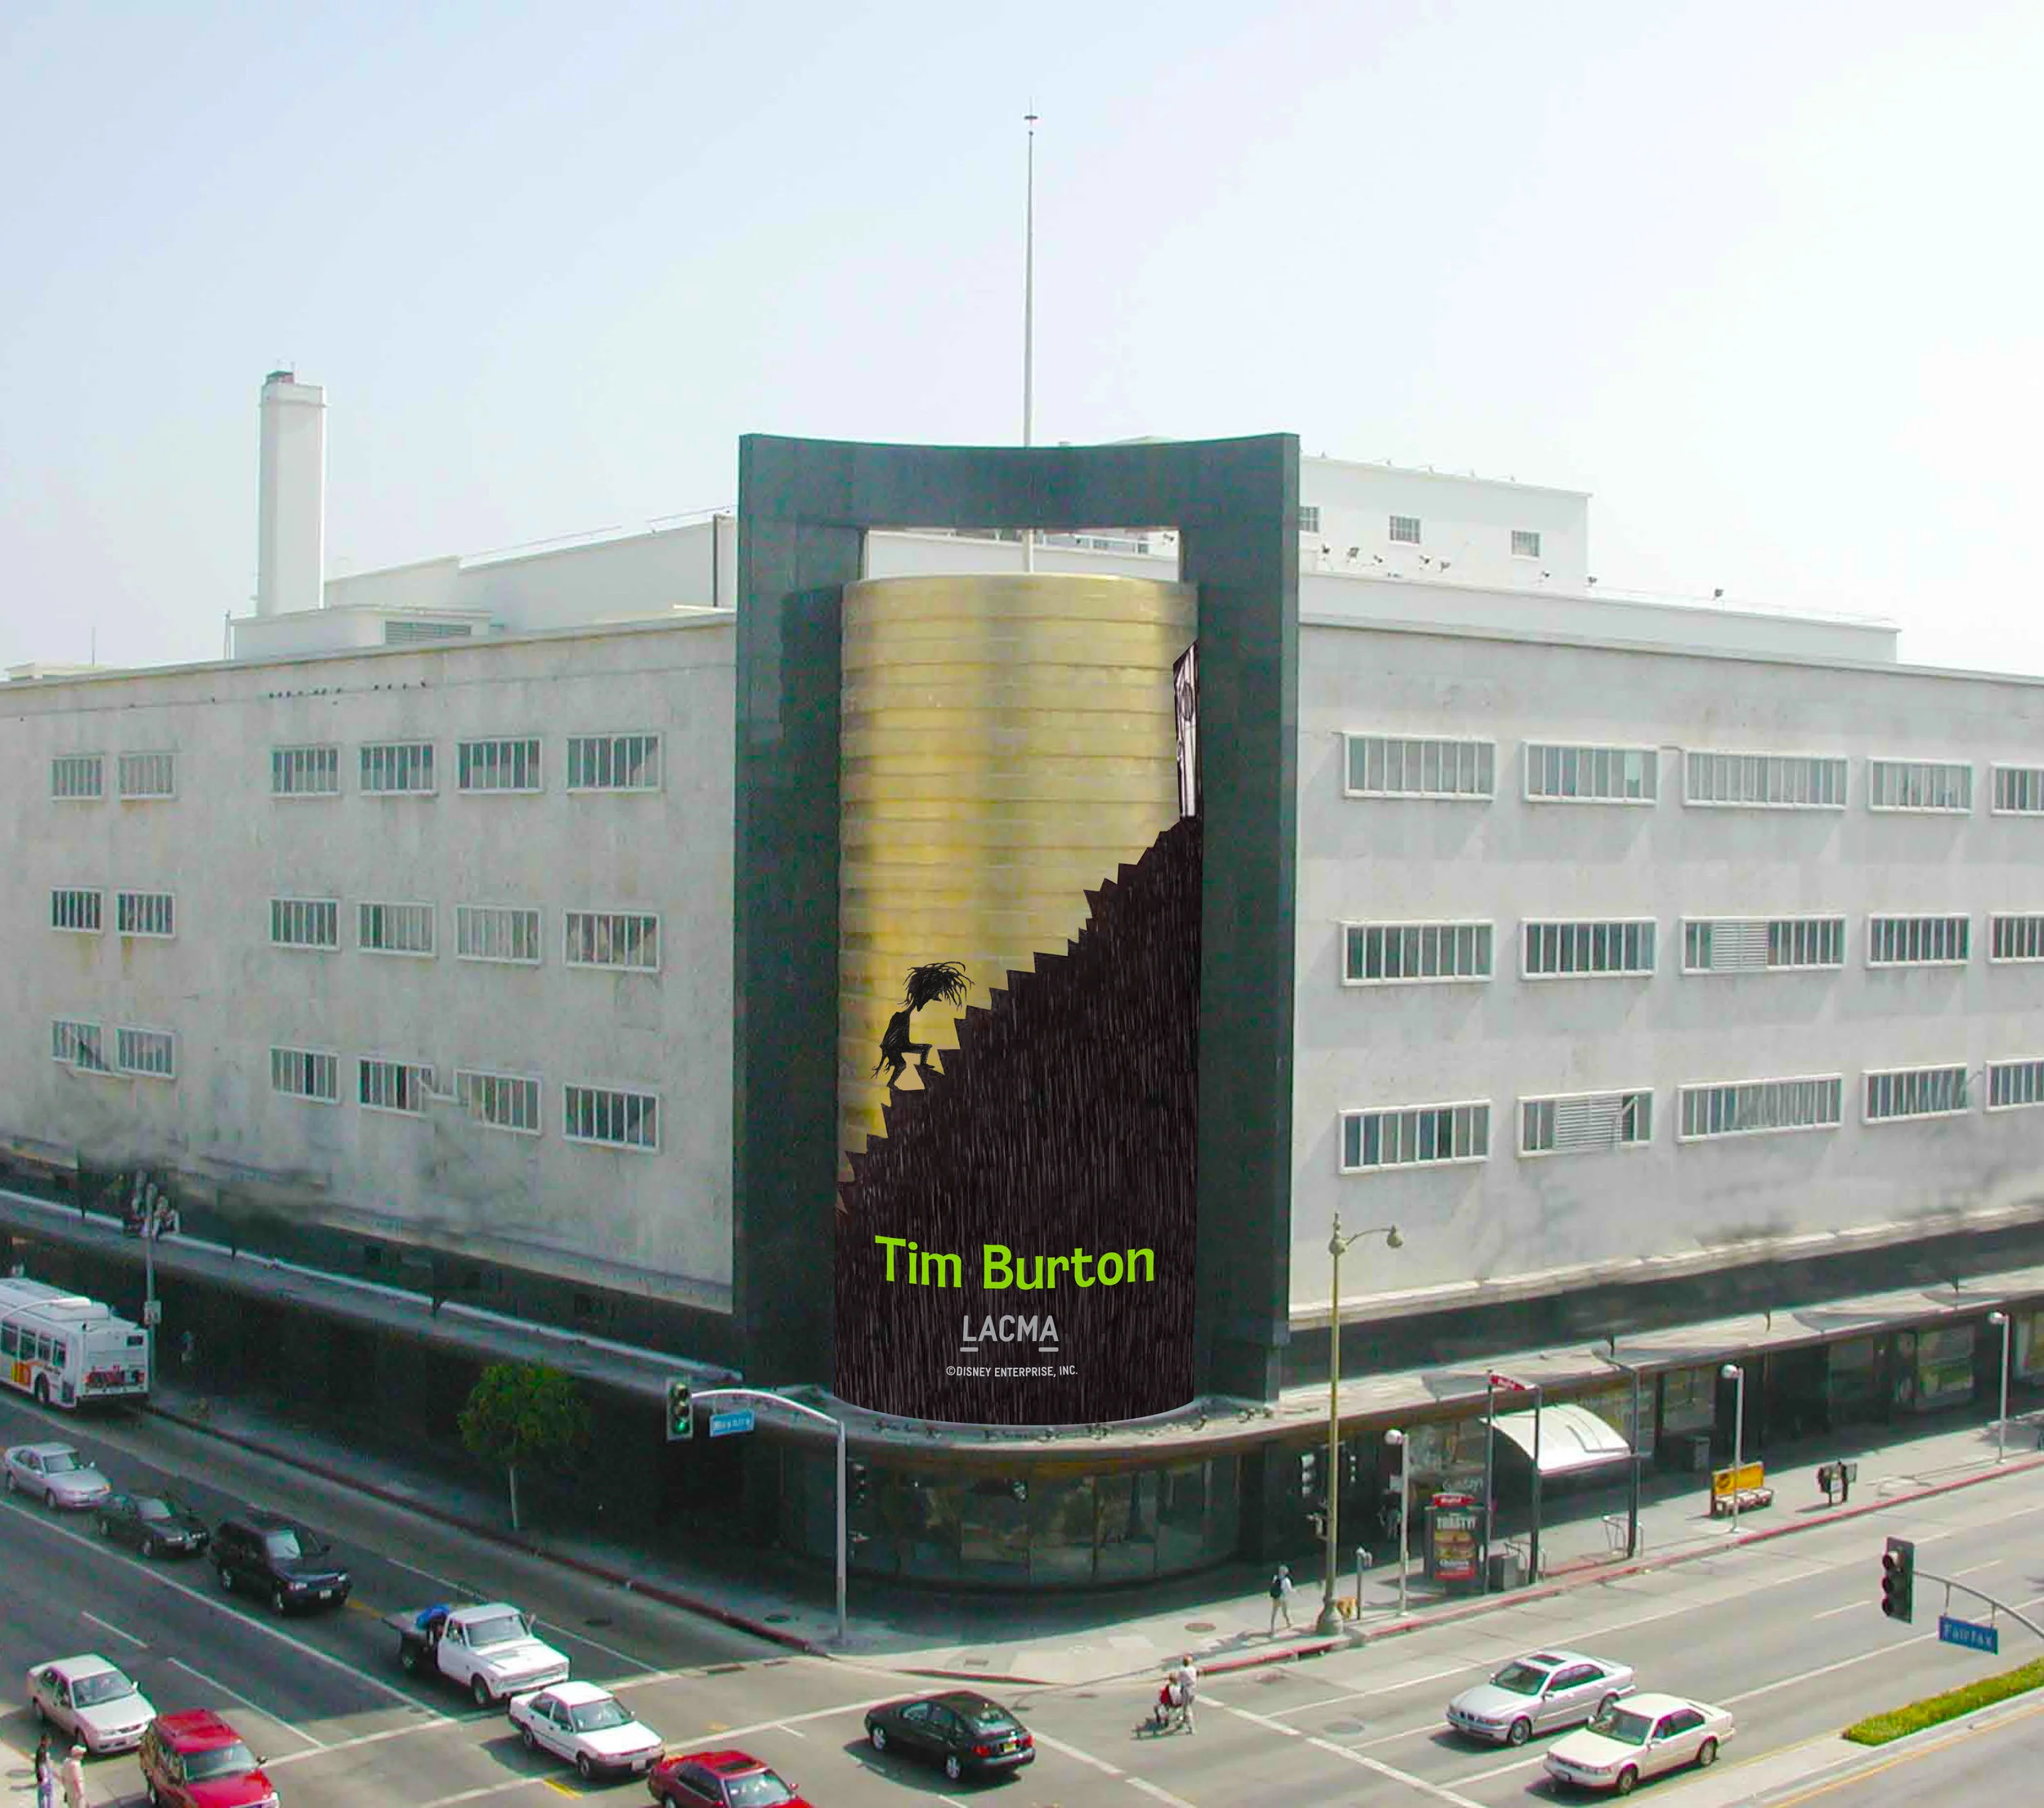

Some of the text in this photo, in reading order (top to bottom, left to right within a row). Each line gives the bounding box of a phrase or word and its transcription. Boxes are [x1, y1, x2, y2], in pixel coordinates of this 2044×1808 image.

[875, 1235, 1154, 1290] Tim Burton
[961, 1314, 1060, 1343] LACMA
[946, 1365, 1078, 1378] ©DISNEY ENTERPRISE, INC.
